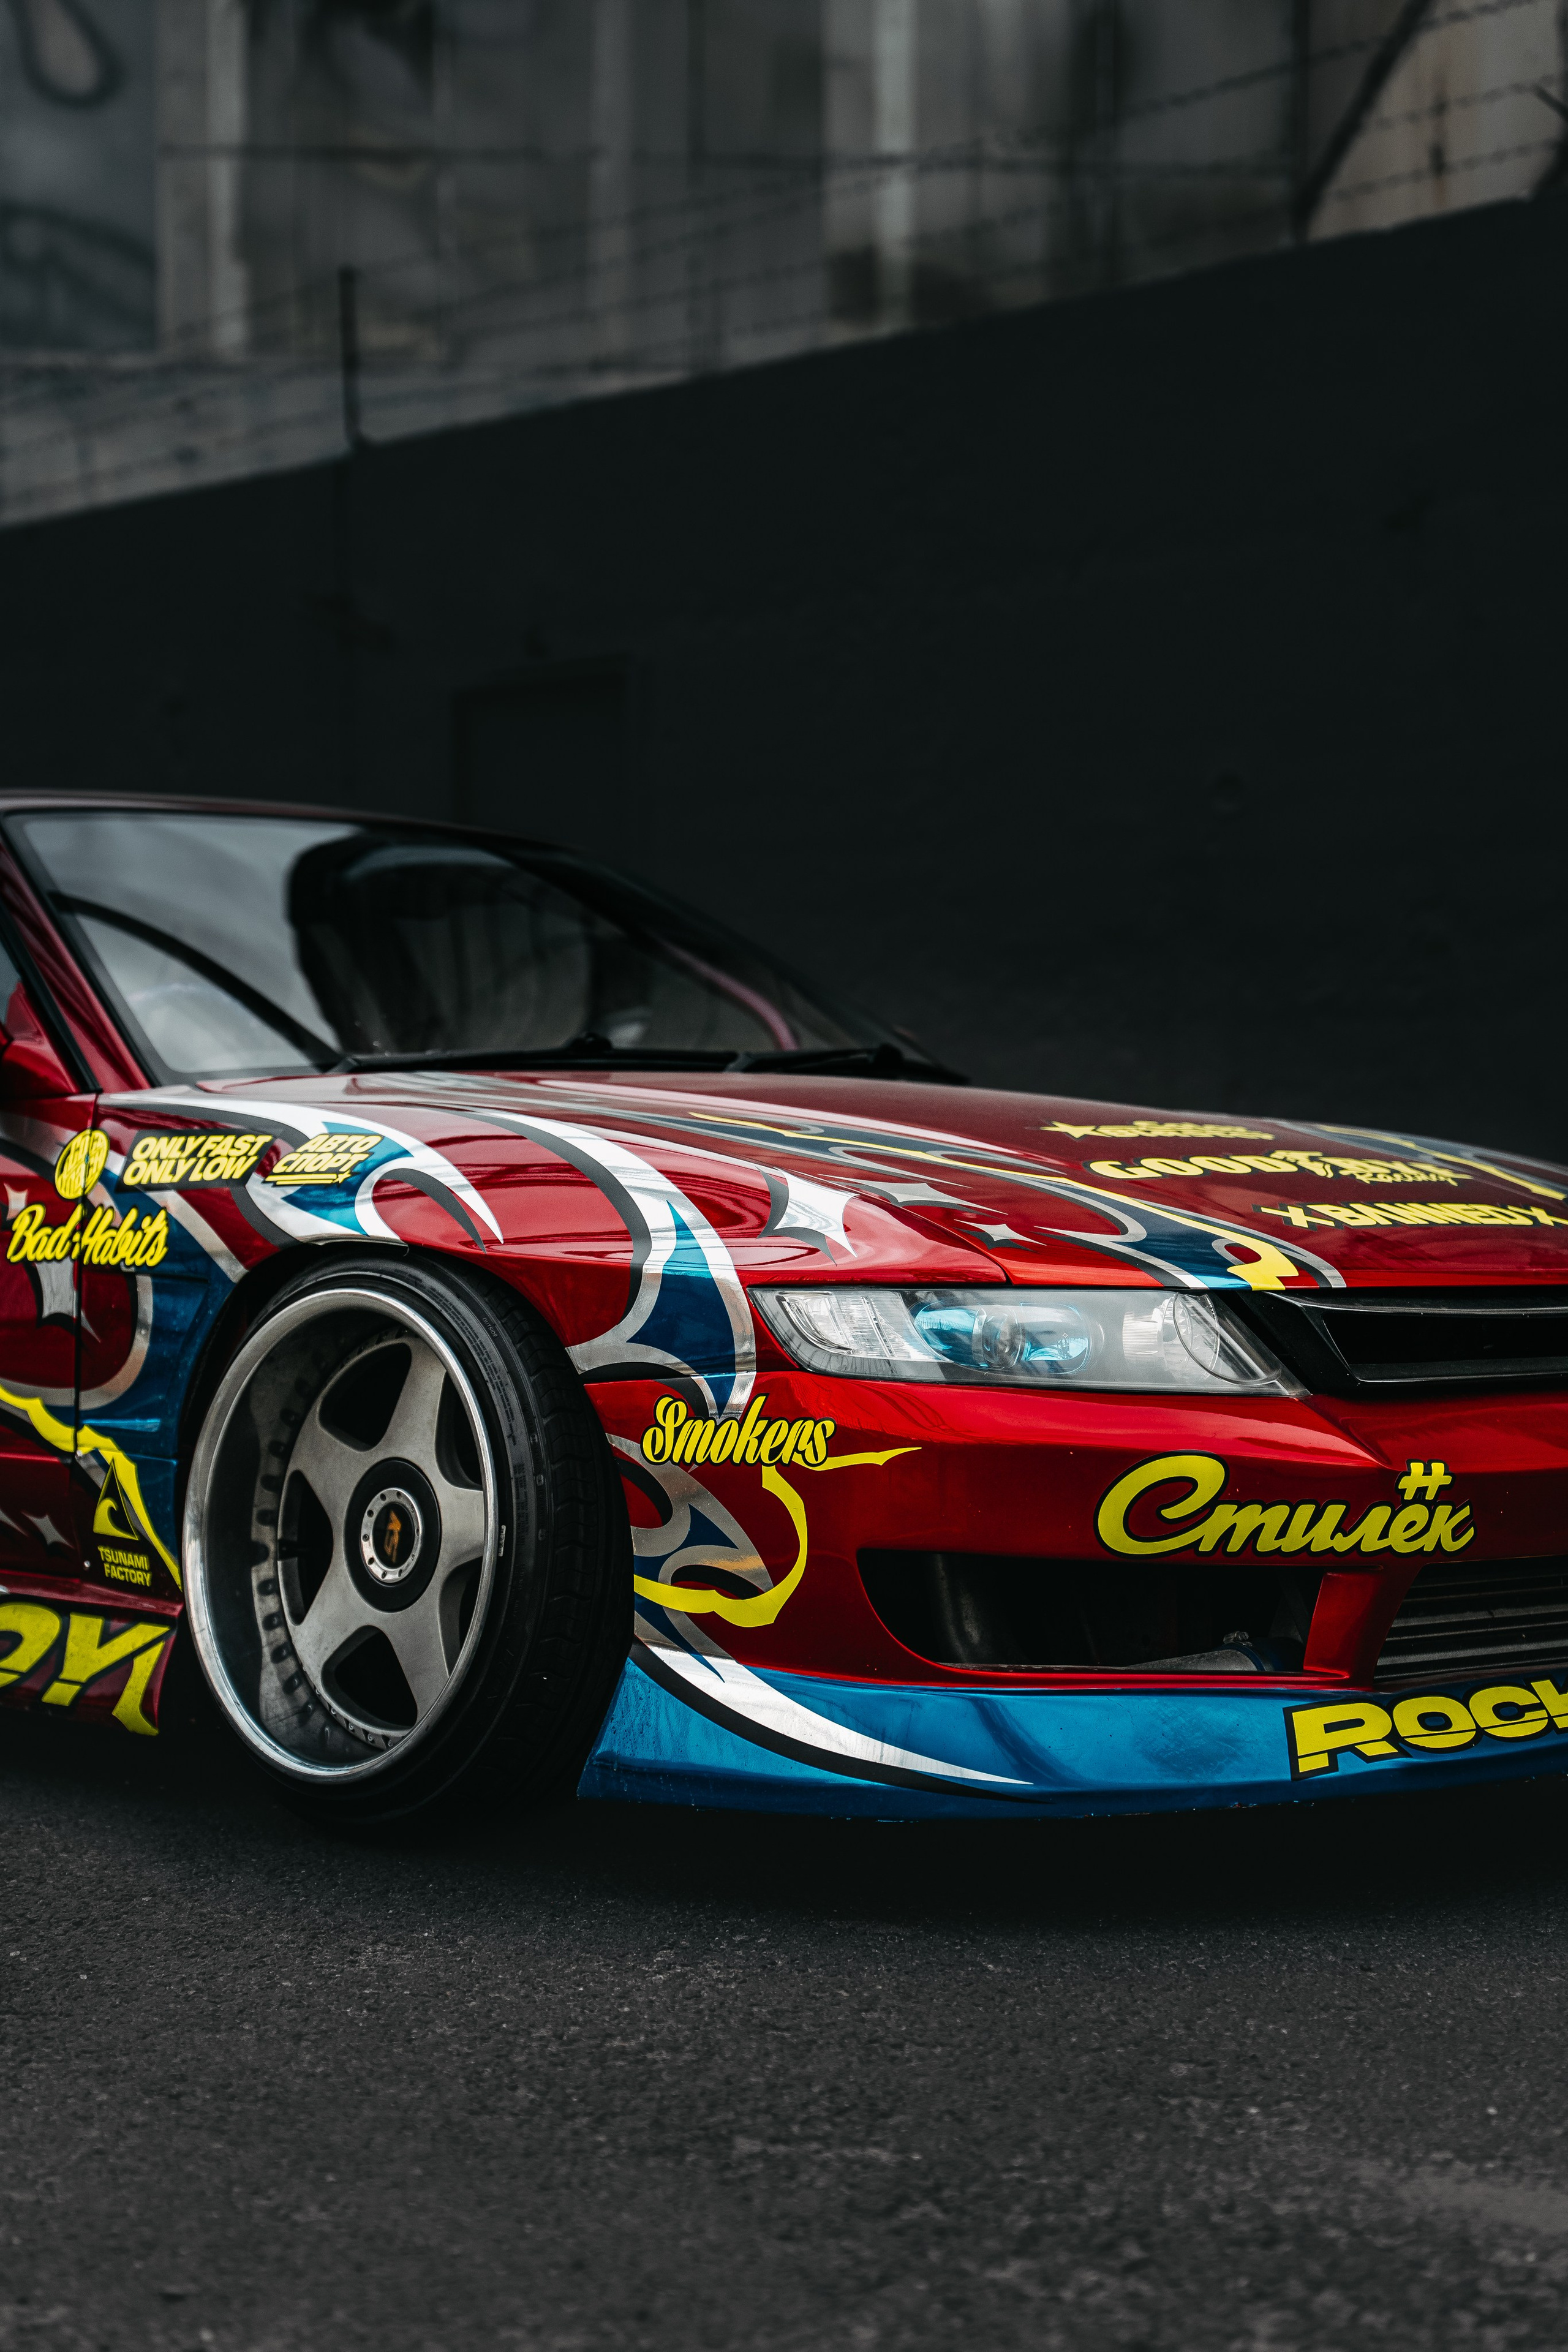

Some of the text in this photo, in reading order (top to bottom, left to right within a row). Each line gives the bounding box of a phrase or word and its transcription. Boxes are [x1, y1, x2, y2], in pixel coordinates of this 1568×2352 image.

[132, 1135, 273, 1159] ONLY FAST
[295, 1134, 384, 1153] АВТО
[123, 1156, 259, 1186] ONLY LOW
[271, 1153, 369, 1174] СПОРТ
[6, 1203, 169, 1267] Bad Habits
[482, 1317, 498, 1338] OUTSIDE
[641, 1395, 836, 1466] Smokers
[97, 1546, 149, 1571] TSUNAMI
[104, 1562, 152, 1587] FACTORY
